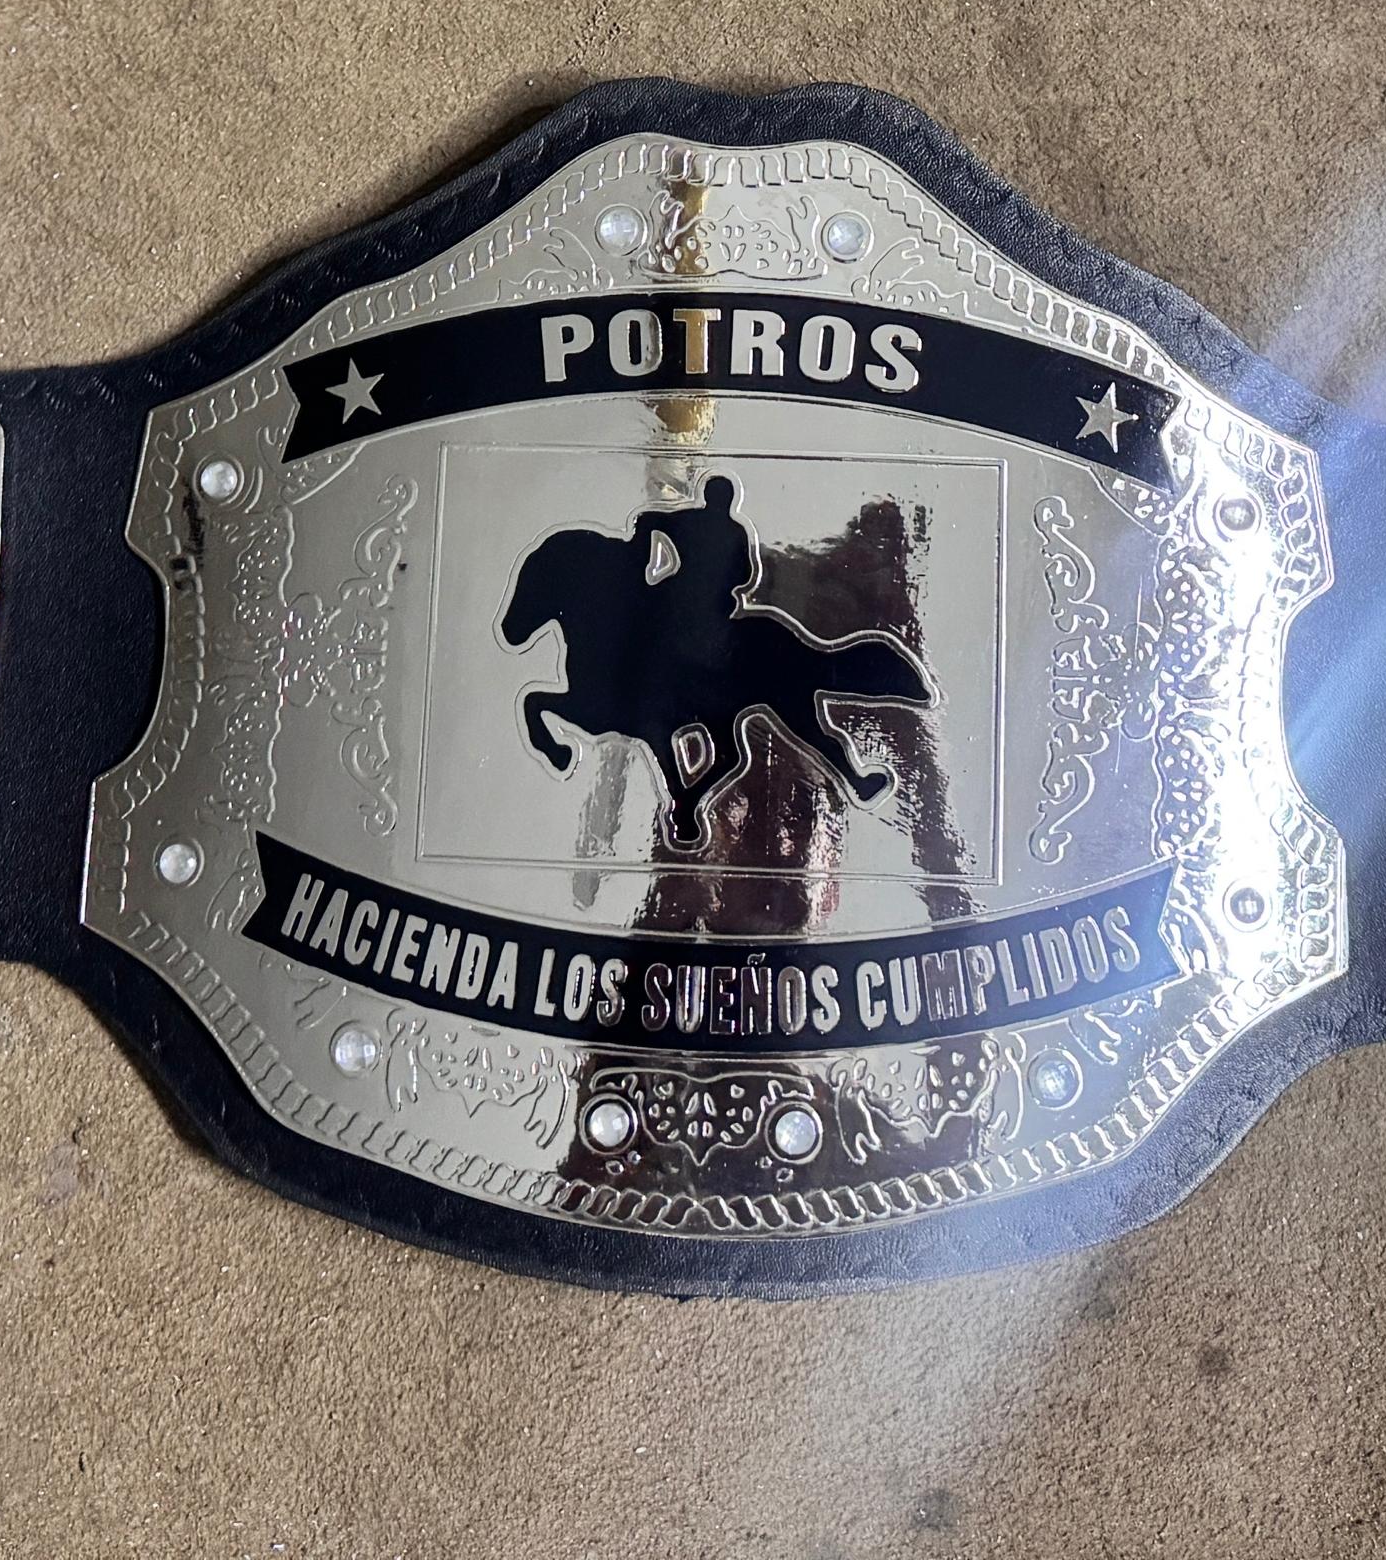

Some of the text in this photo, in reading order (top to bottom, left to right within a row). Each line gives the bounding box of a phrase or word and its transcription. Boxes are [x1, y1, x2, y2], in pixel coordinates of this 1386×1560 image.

[541, 308, 923, 393] POTROS
[281, 873, 1140, 1035] HACIENDA LOS SUEÑOS CUMPLIDOS
